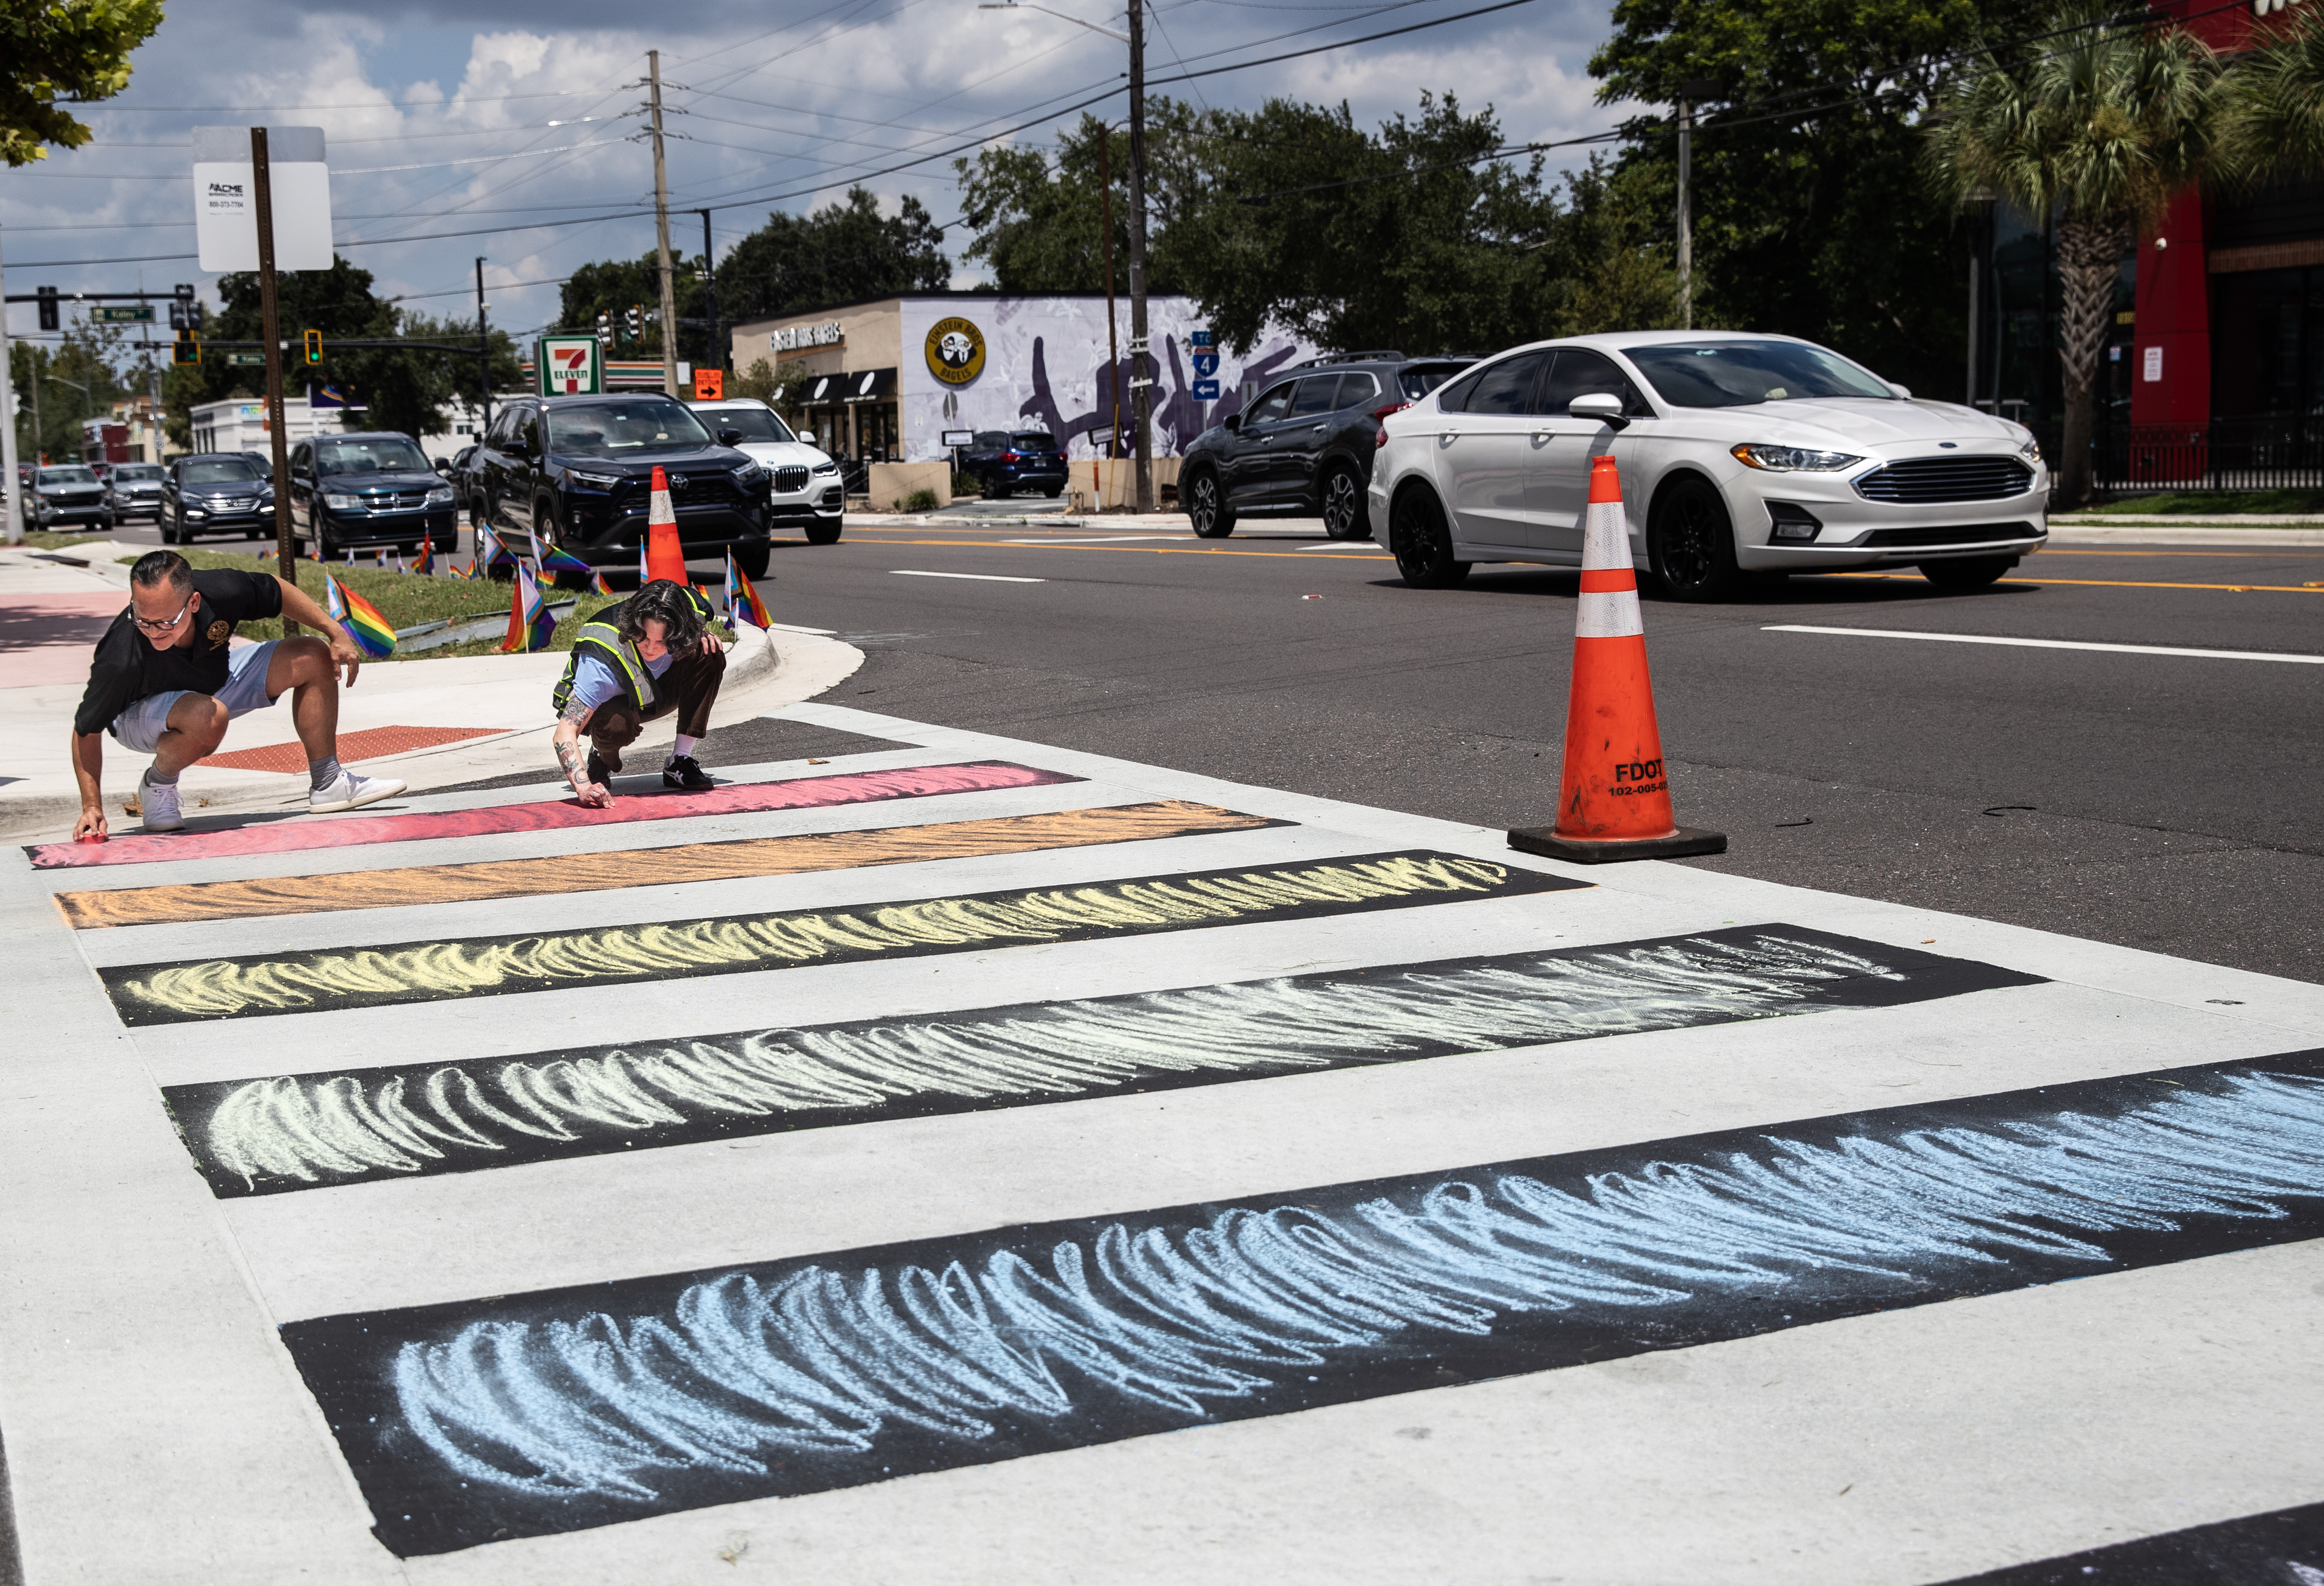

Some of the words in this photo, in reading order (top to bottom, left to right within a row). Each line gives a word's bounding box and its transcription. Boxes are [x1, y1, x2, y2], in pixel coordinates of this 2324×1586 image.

[111, 310, 136, 320] Kaley
[929, 320, 963, 345] EINSTEIN
[965, 324, 983, 347] BROS
[242, 356, 261, 364] Kaley
[1201, 357, 1210, 373] 4
[554, 349, 586, 393] 7
[940, 368, 971, 380] BAGELS
[1615, 759, 1662, 782] FDOT
